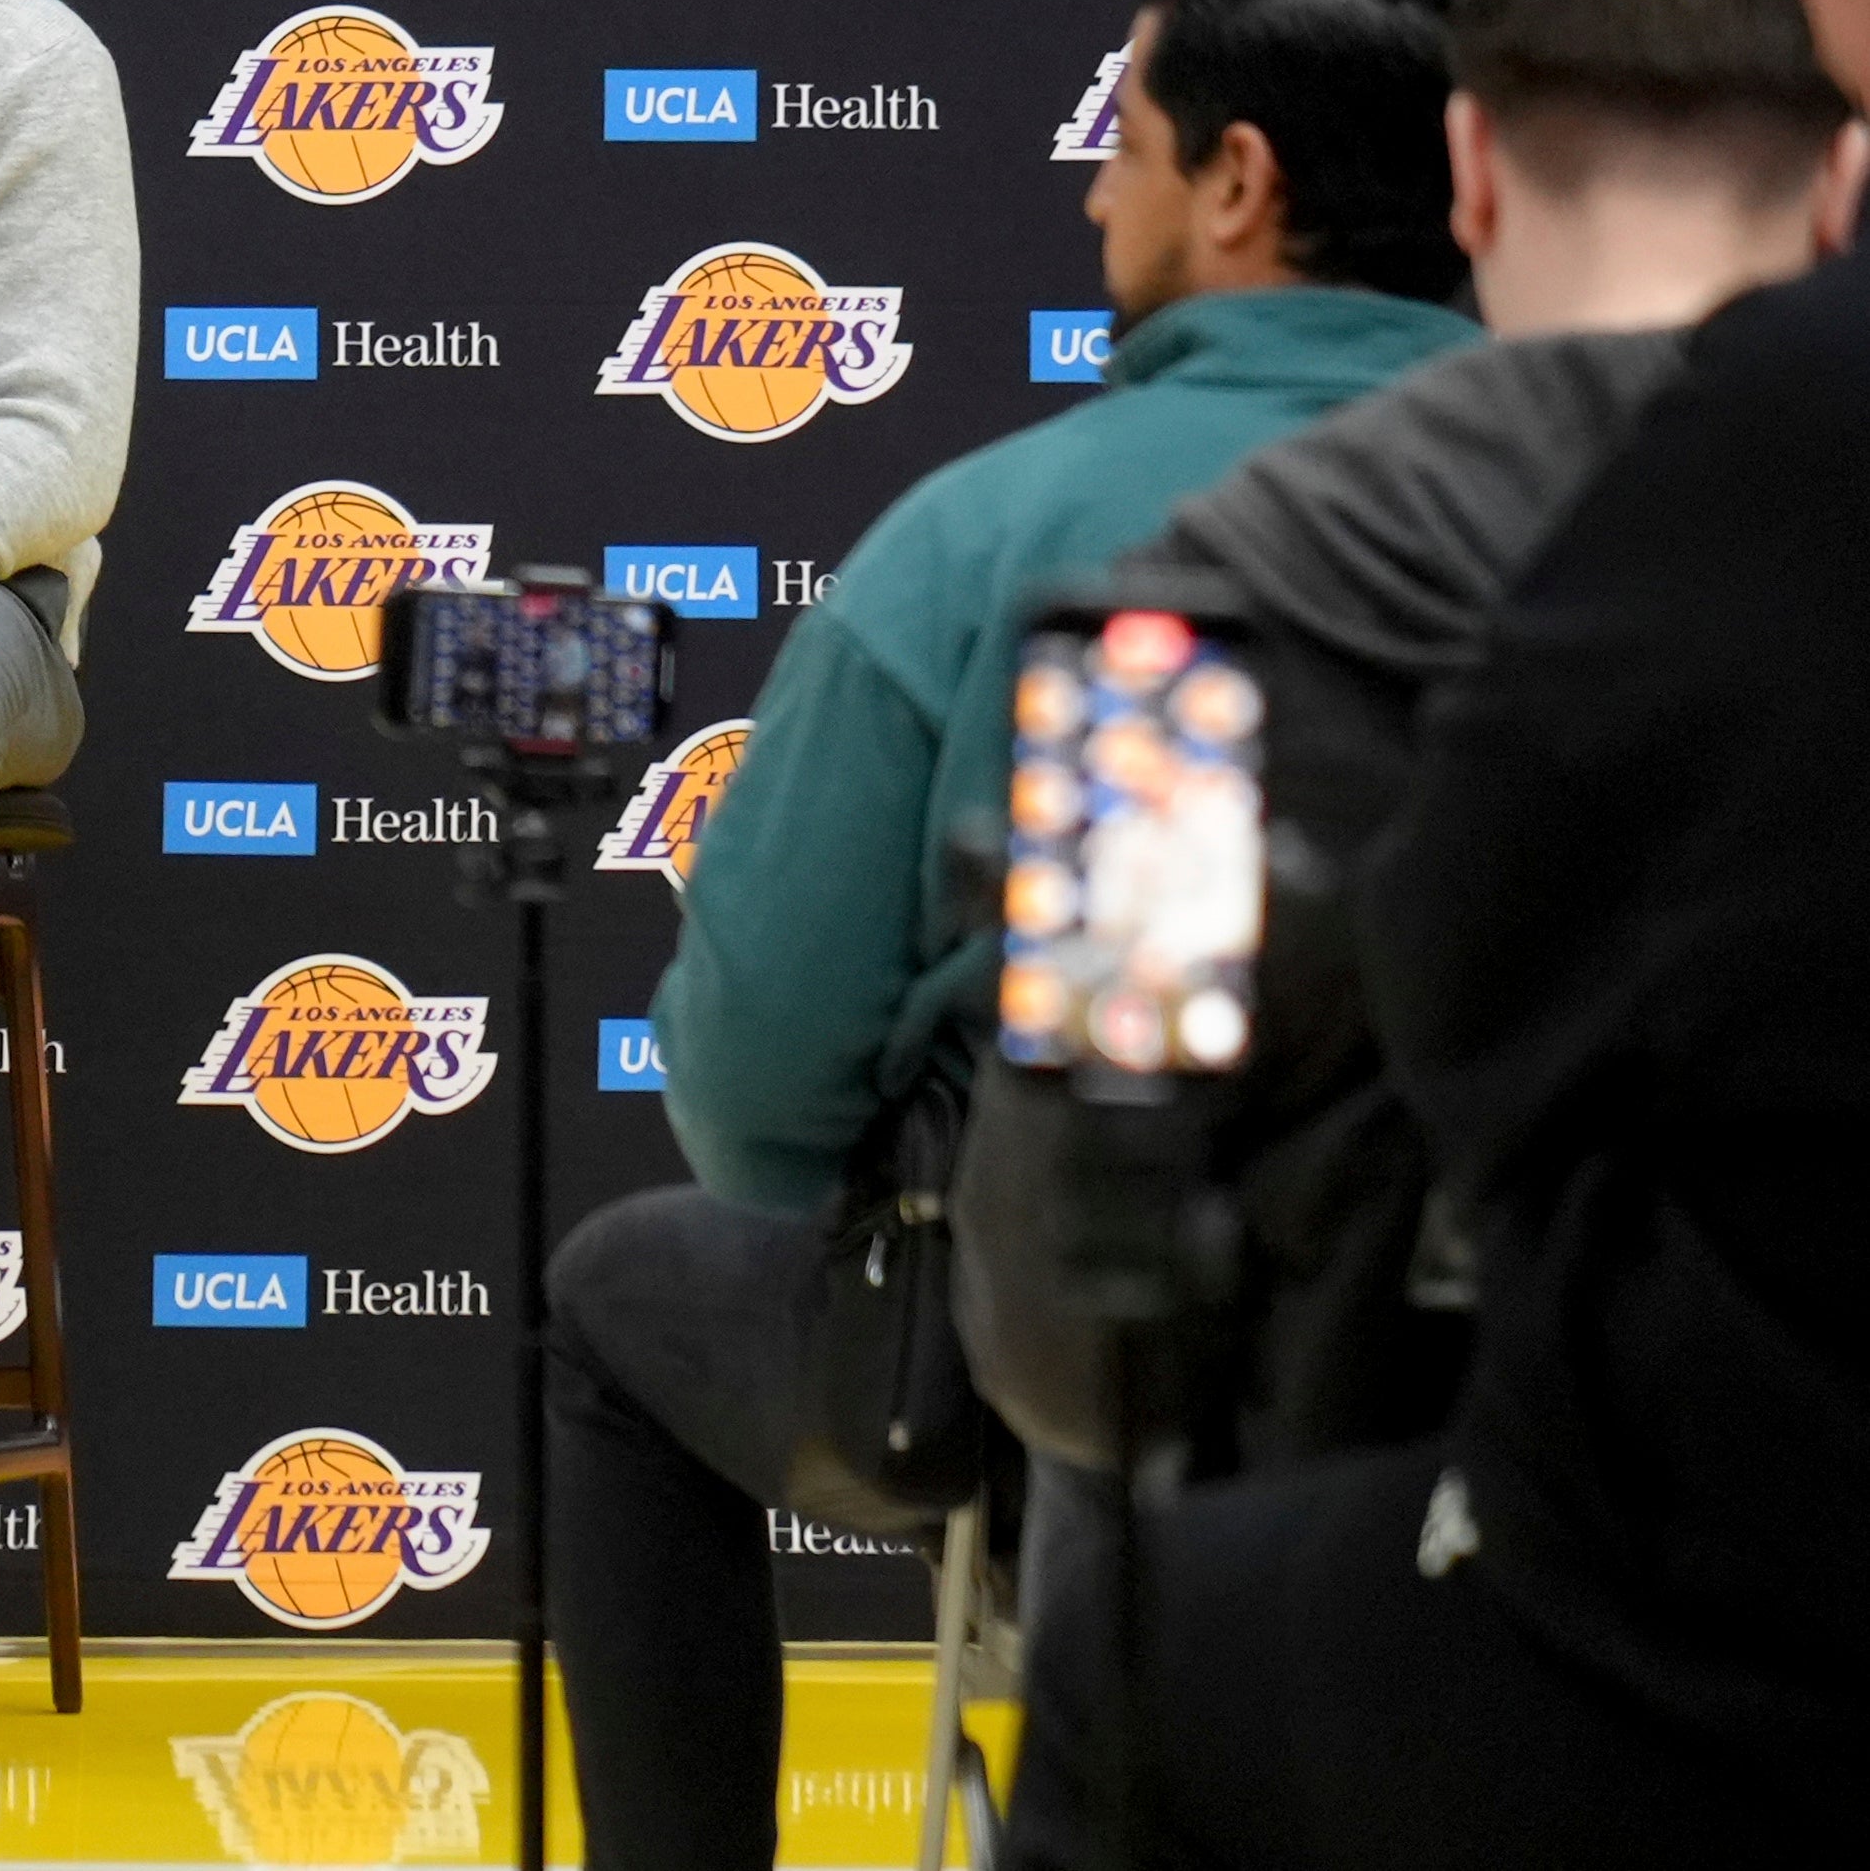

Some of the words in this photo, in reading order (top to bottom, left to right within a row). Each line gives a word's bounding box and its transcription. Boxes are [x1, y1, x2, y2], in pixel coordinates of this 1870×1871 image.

[211, 58, 482, 152] LAKERS
[626, 86, 737, 124] UCLA
[773, 84, 939, 129] Health
[703, 293, 755, 312] LOS
[759, 293, 890, 313] ANGELES
[186, 325, 298, 362] UCLA
[333, 322, 500, 366] Health
[620, 294, 891, 392] LAKERS
[627, 564, 739, 602] UCLA
[185, 800, 297, 838] UCLA
[332, 798, 500, 842] Health
[203, 1005, 476, 1102] LAKERS
[175, 1272, 287, 1310] UCLA
[323, 1270, 491, 1315] Health
[279, 1479, 332, 1497] LOS
[336, 1479, 468, 1498] ANGELES
[193, 1480, 469, 1577] LAKERS
